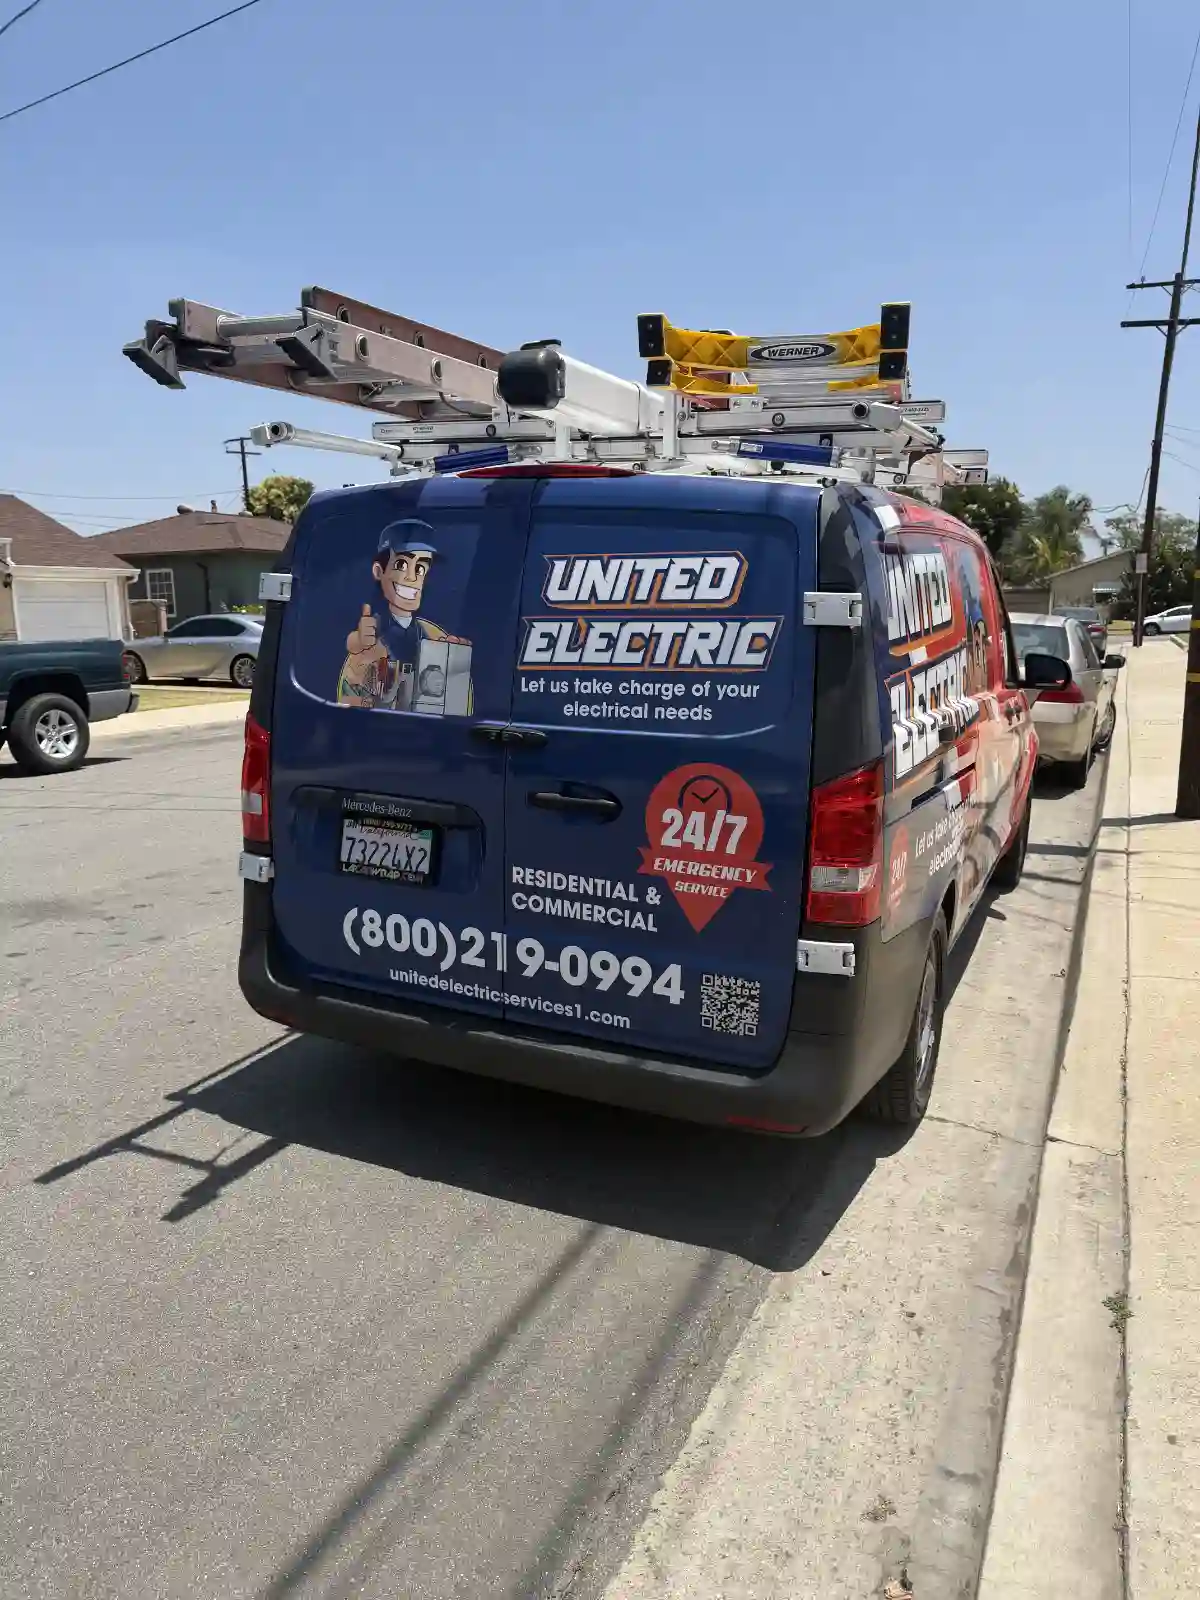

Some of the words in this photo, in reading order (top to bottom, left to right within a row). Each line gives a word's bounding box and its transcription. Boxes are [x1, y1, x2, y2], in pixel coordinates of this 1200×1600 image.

[767, 347, 819, 357] WERNER
[546, 556, 741, 601] UNITED
[523, 621, 777, 666] ELECTRIC
[521, 677, 546, 693] Let
[551, 680, 568, 693] us
[574, 678, 613, 694] take
[619, 679, 687, 700] charge
[692, 680, 710, 697] of
[716, 683, 760, 700] your
[563, 702, 649, 720] electrical
[654, 705, 712, 721] needs
[342, 798, 412, 817] Mercedes-Benz
[660, 808, 748, 855] 24/7
[512, 865, 639, 903] RESIDENTIAL
[645, 886, 661, 906] &
[653, 857, 758, 884] EMERGENCY
[674, 881, 729, 898] SERVICE
[511, 892, 658, 933] COMMERCIAL
[343, 906, 685, 1005] (800)219-0994
[390, 967, 631, 1029] unitedelectricservices1.com
